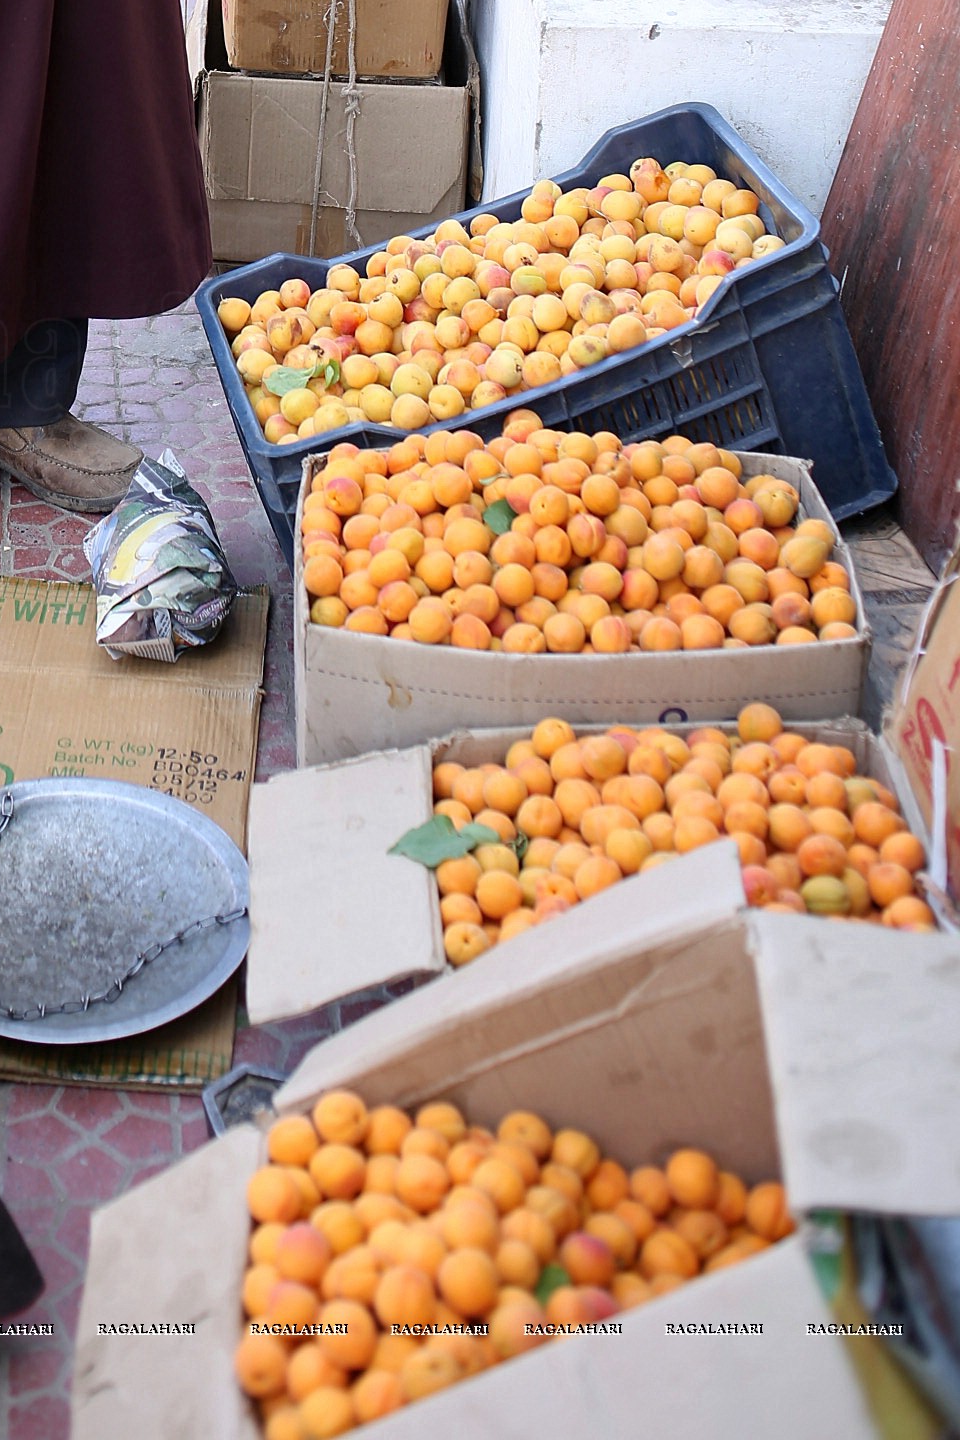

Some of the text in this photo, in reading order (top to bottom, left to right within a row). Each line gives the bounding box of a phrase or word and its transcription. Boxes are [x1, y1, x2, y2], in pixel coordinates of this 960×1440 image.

[13, 599, 87, 626] WITH
[53, 751, 106, 765] Batch
[83, 738, 116, 751] WT
[120, 742, 155, 758] (kg)
